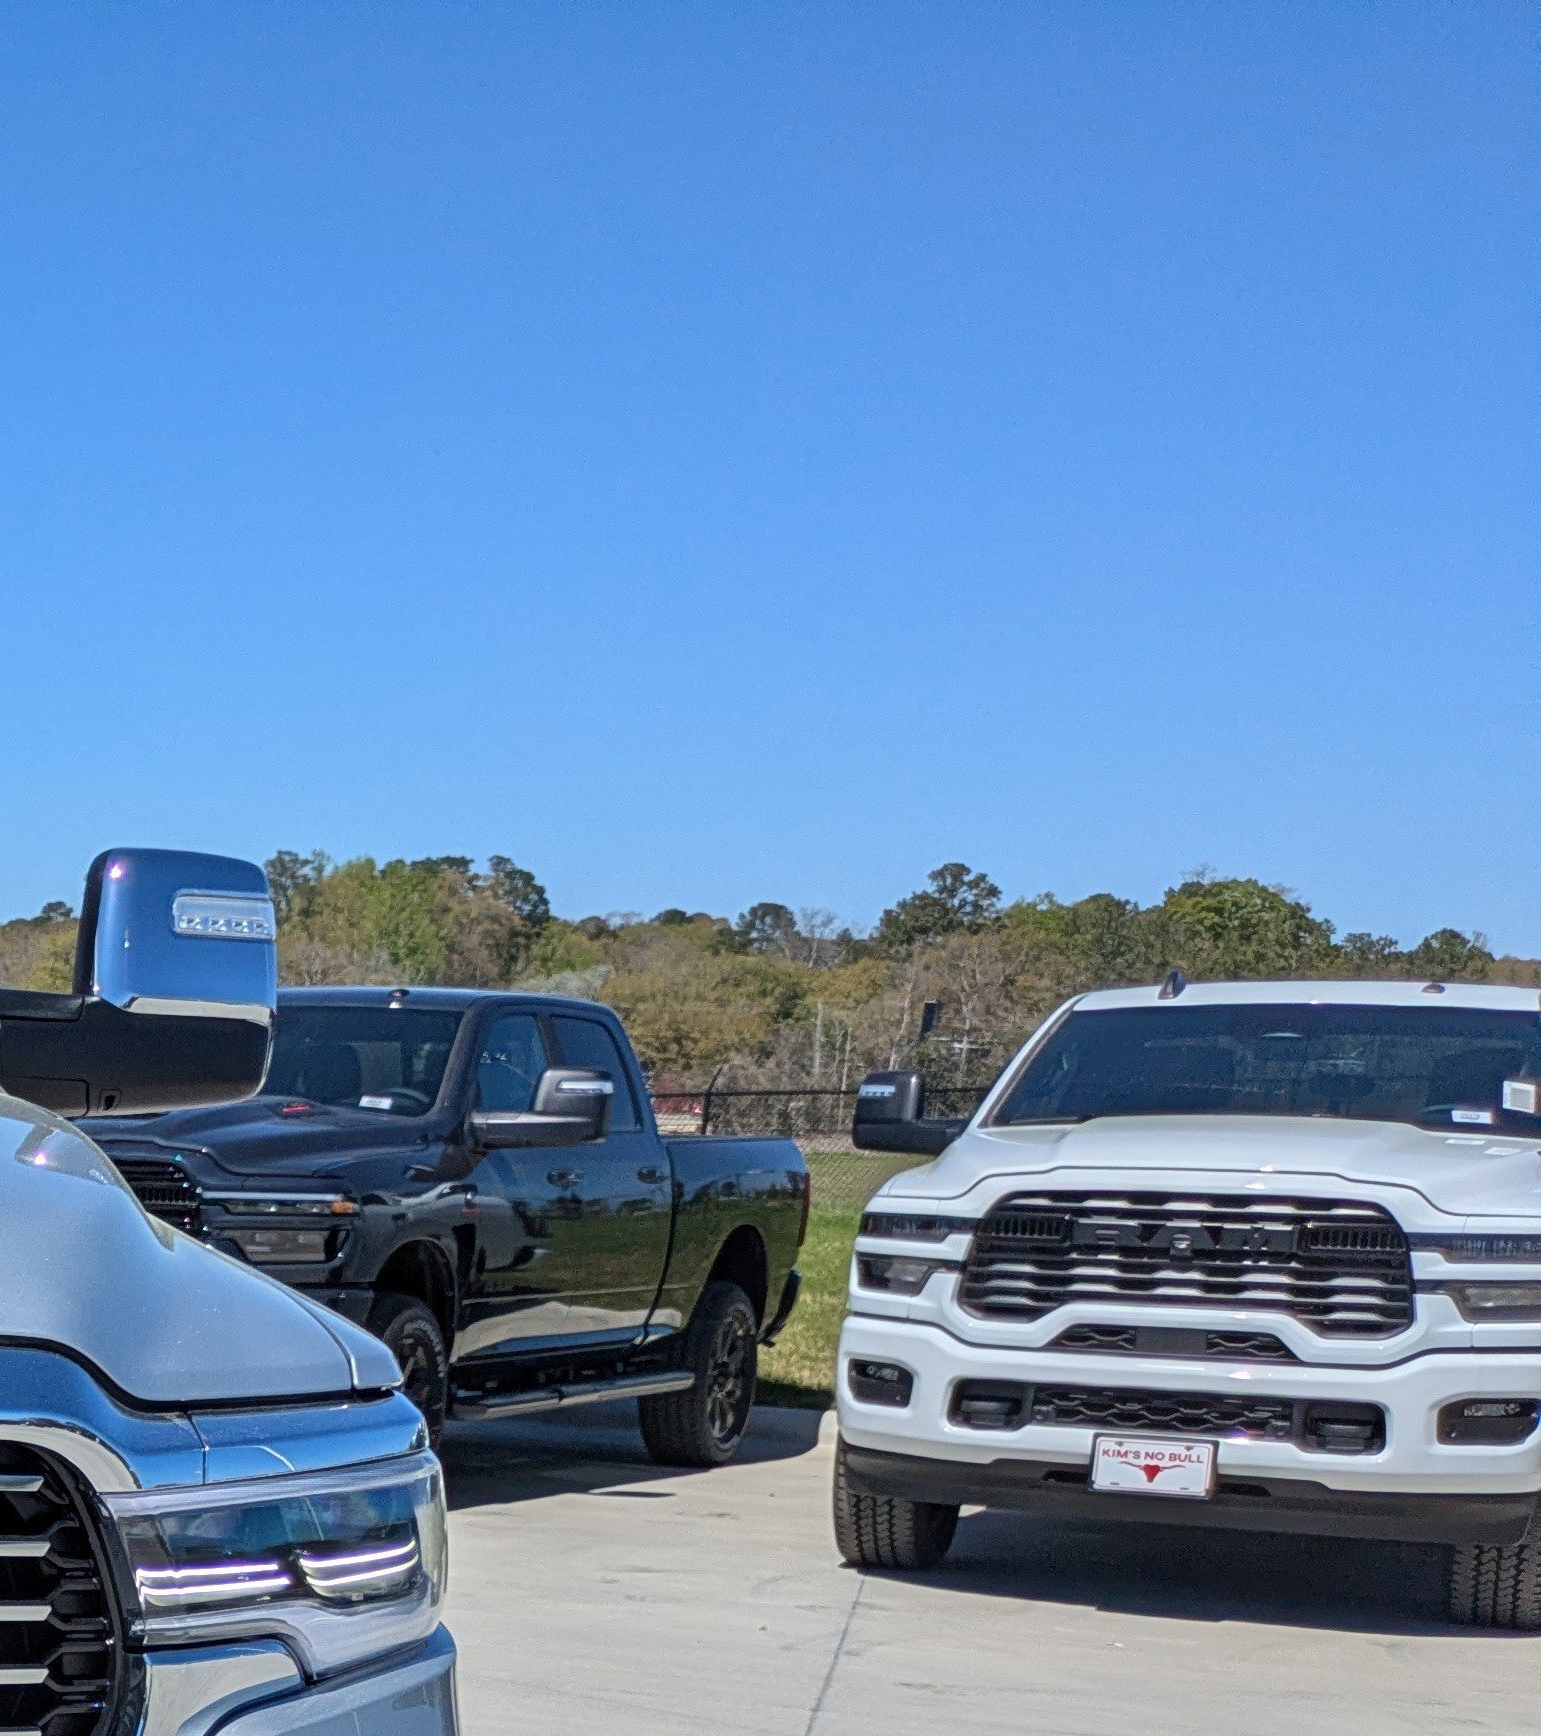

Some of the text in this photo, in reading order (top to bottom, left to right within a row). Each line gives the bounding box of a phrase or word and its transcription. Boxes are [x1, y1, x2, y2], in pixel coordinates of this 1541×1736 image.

[1101, 1448, 1204, 1464] KIM'S NO BULL
